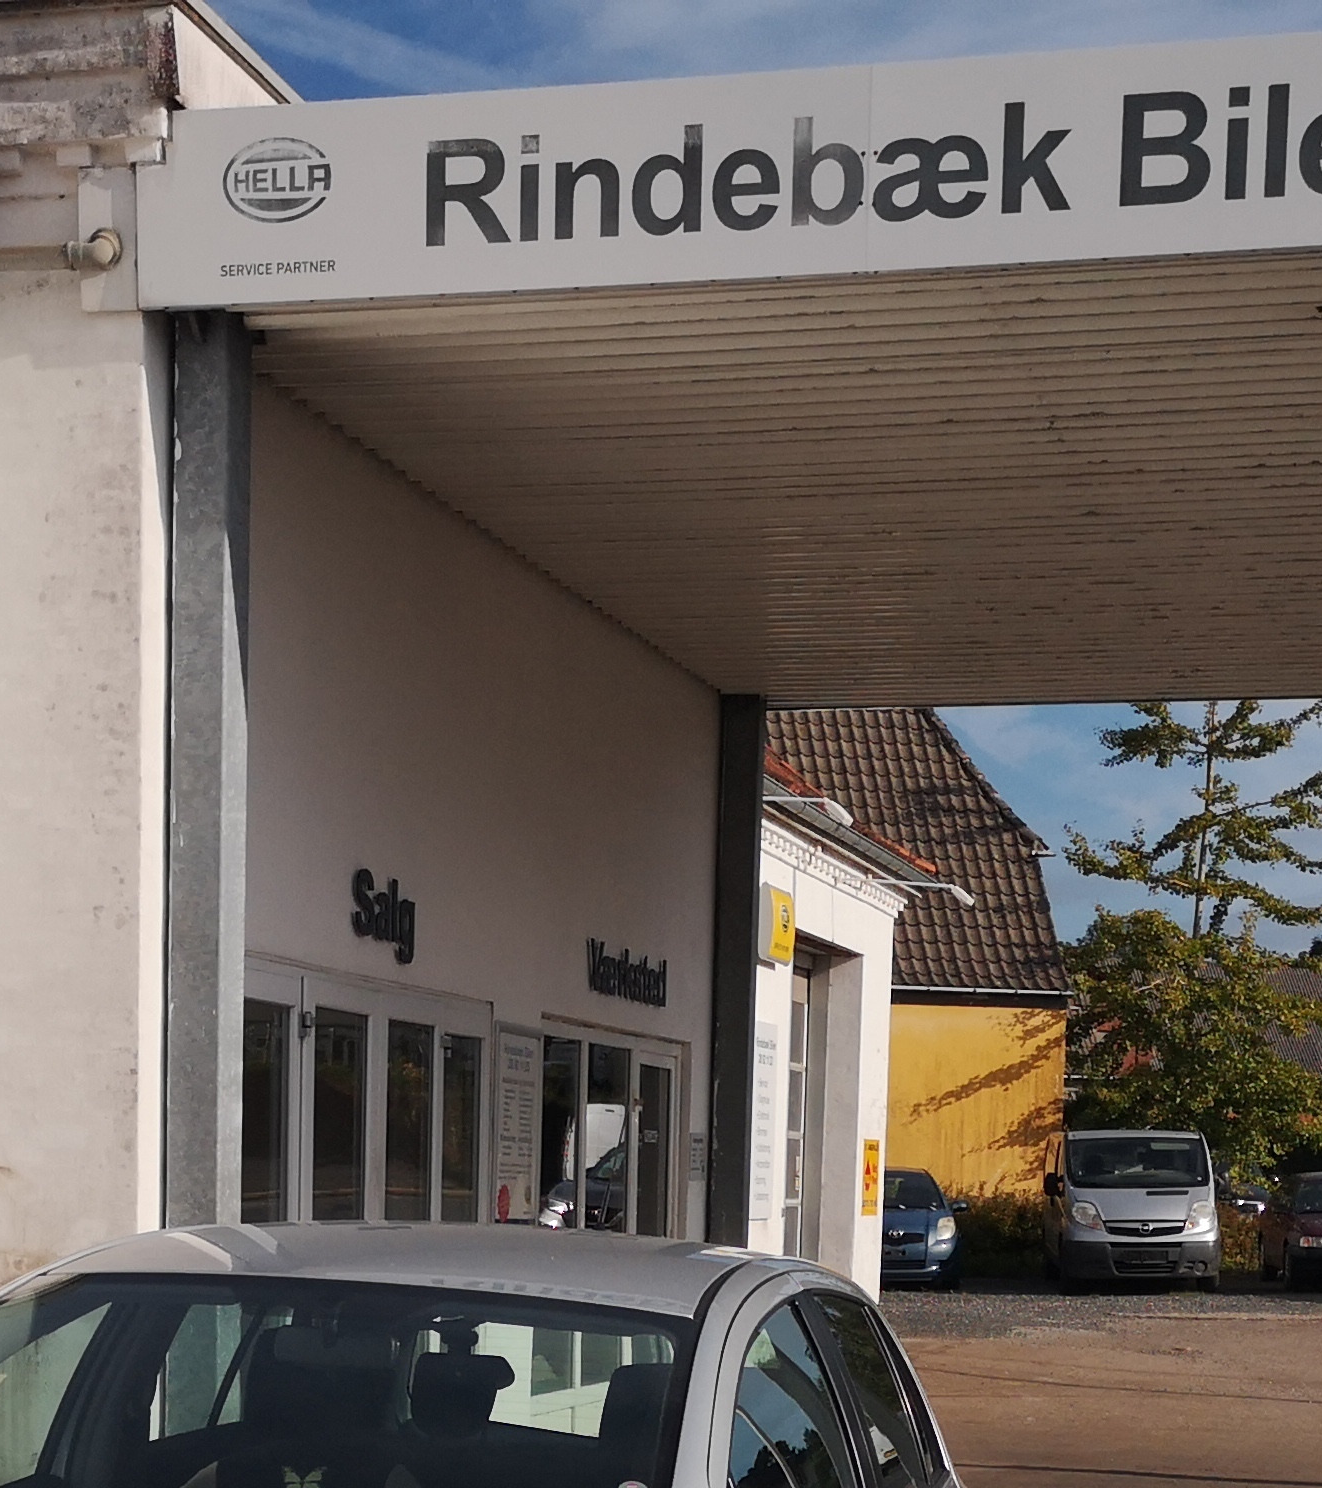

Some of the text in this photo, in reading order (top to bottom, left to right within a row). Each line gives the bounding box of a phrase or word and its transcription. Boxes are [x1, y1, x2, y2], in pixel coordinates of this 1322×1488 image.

[234, 163, 332, 193] HELLA
[424, 101, 1070, 249] Rindebæk
[220, 260, 337, 278] SERVICE PARTNER
[351, 868, 416, 965] Salg
